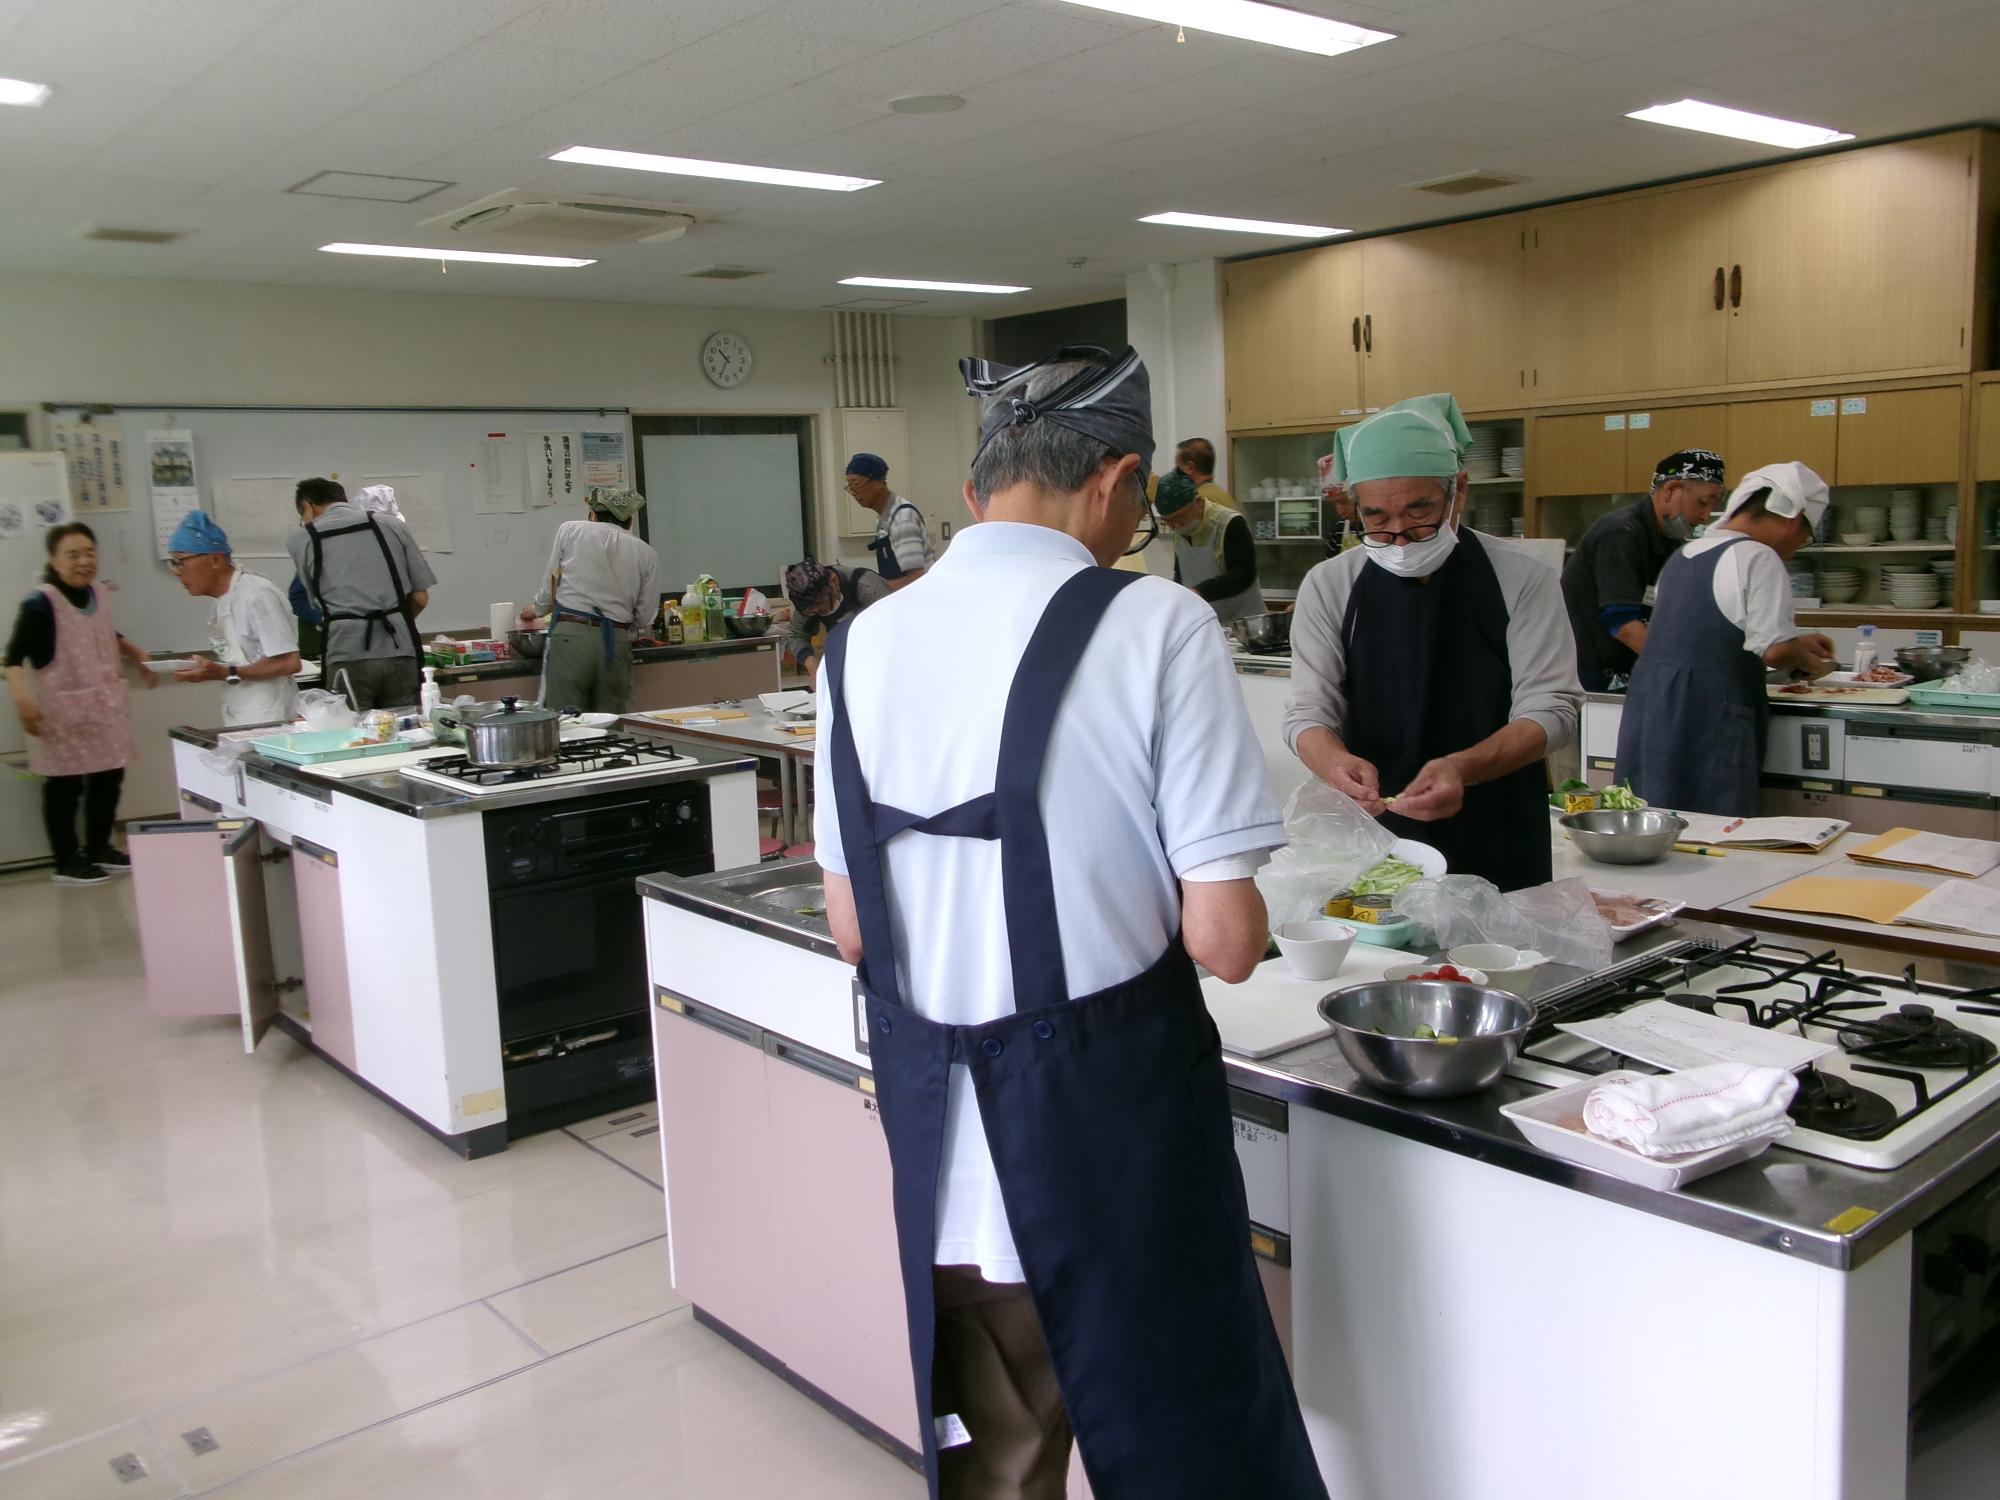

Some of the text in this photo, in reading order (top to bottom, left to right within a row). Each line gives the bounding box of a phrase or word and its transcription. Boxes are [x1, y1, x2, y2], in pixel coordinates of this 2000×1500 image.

[543, 435, 554, 498] 手洗いをしましょう
